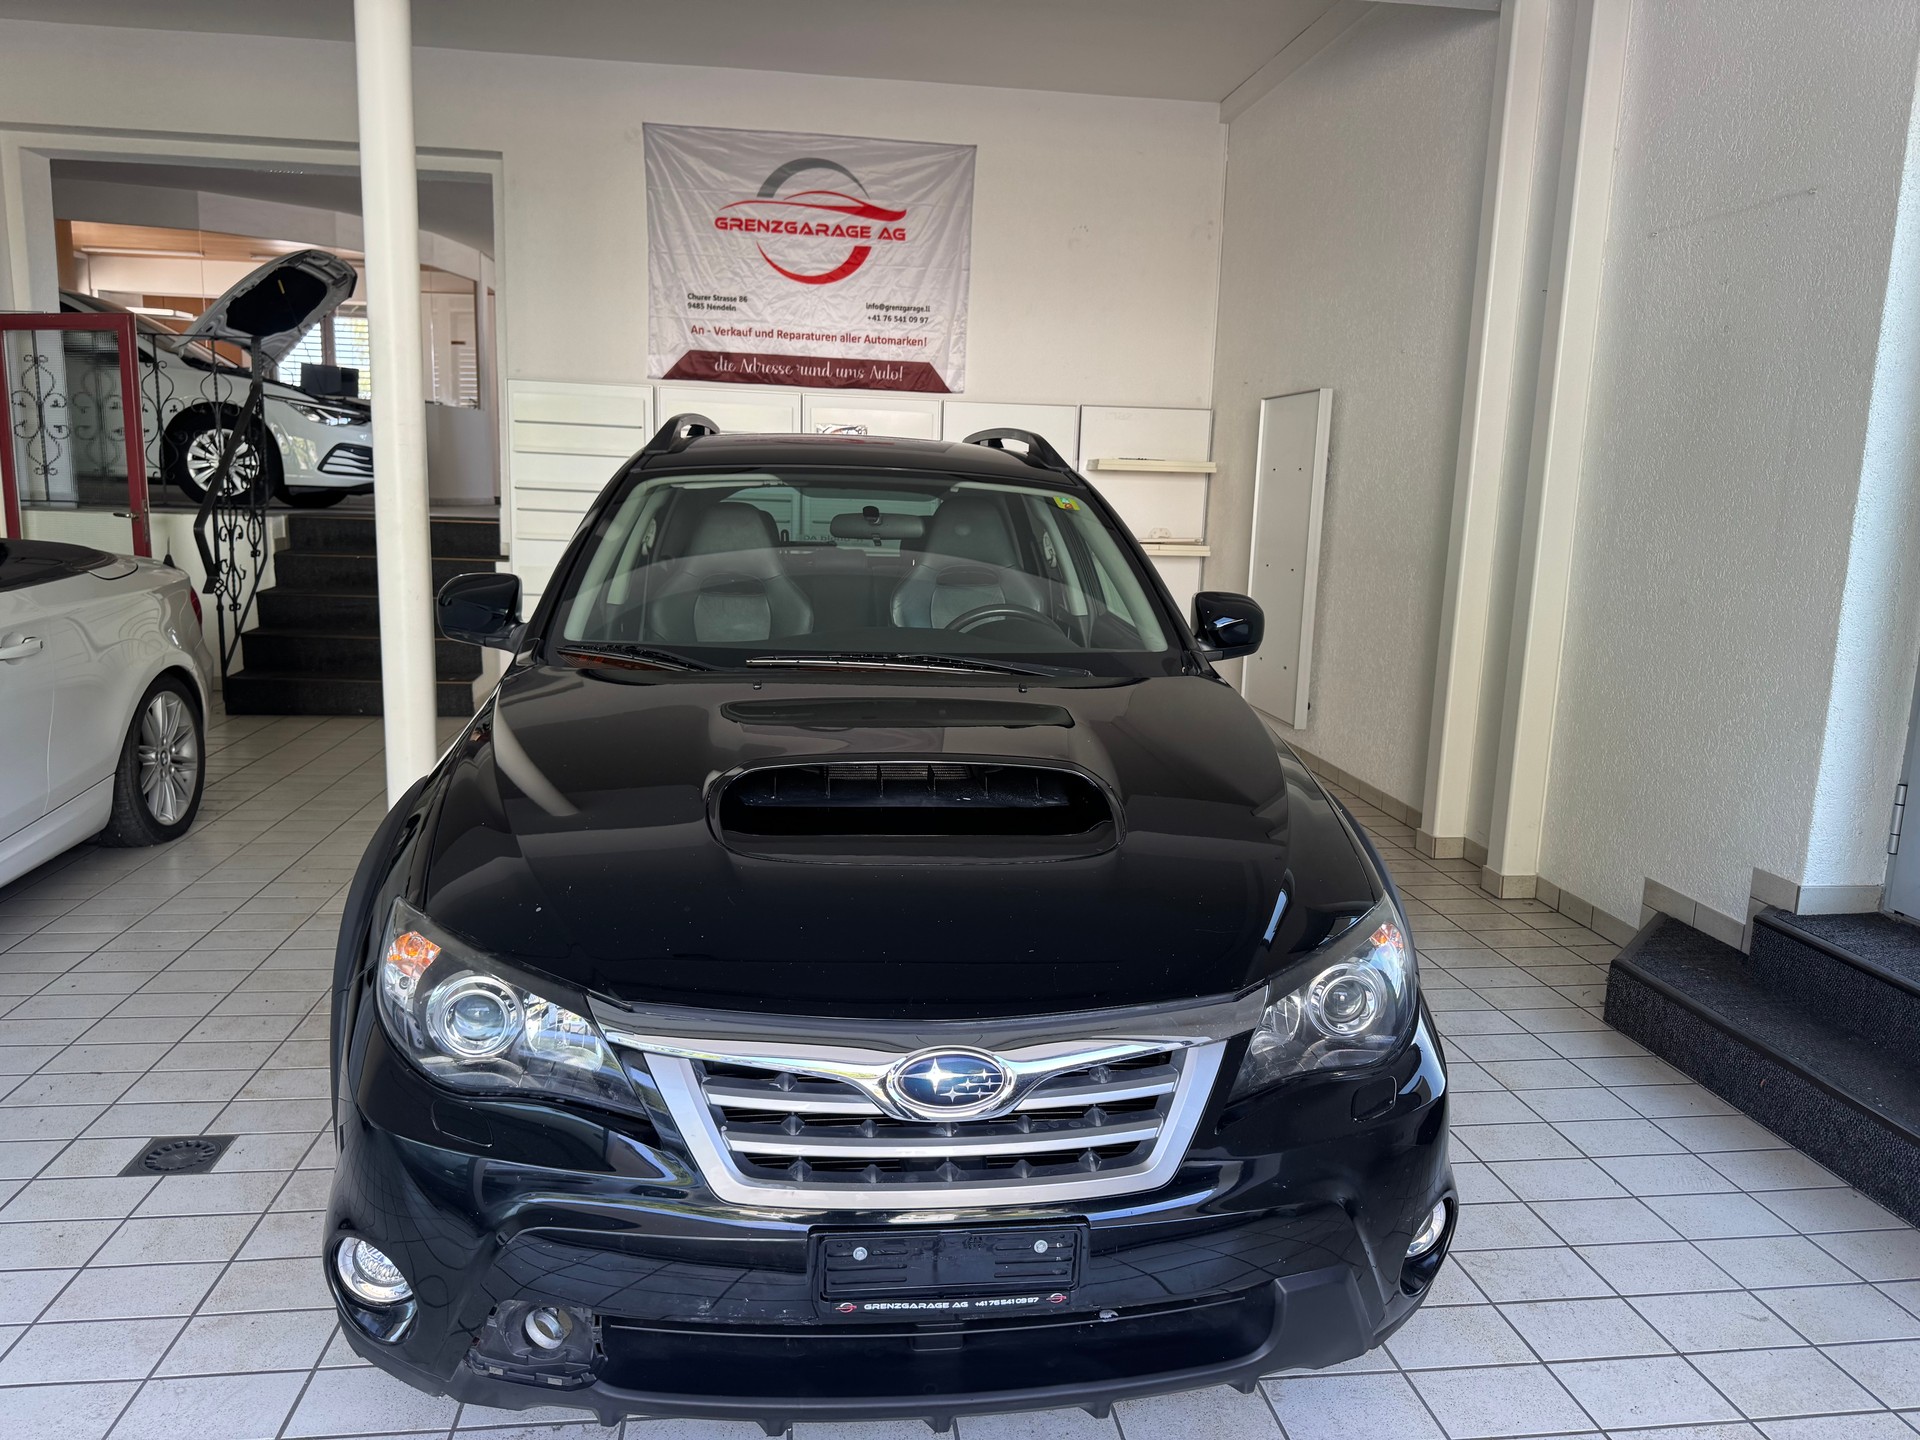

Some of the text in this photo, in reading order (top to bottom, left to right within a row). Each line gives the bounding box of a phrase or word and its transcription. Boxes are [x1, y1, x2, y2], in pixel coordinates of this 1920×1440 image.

[714, 216, 906, 241] GRENZGARAGE AG
[687, 292, 711, 301] Churer
[712, 294, 738, 302] Strasse
[687, 302, 736, 311] 9485 Nendeln
[865, 302, 931, 314] info@grenzgarage.li
[867, 314, 881, 322] +41
[883, 314, 892, 322] 76
[893, 315, 907, 323] 541
[919, 316, 929, 324] 97
[690, 324, 705, 335] An
[713, 326, 753, 337] Verkauf
[755, 329, 774, 339] und
[776, 329, 837, 342] Reparaturen
[839, 332, 861, 343] aller
[863, 334, 927, 347] Automarken!
[714, 355, 904, 381] die Adresse rund ums Auto!
[863, 1302, 950, 1310] GRENZGARAGE
[952, 1301, 969, 1309] AG
[988, 1299, 1000, 1307] 76
[1000, 1298, 1015, 1306] 541
